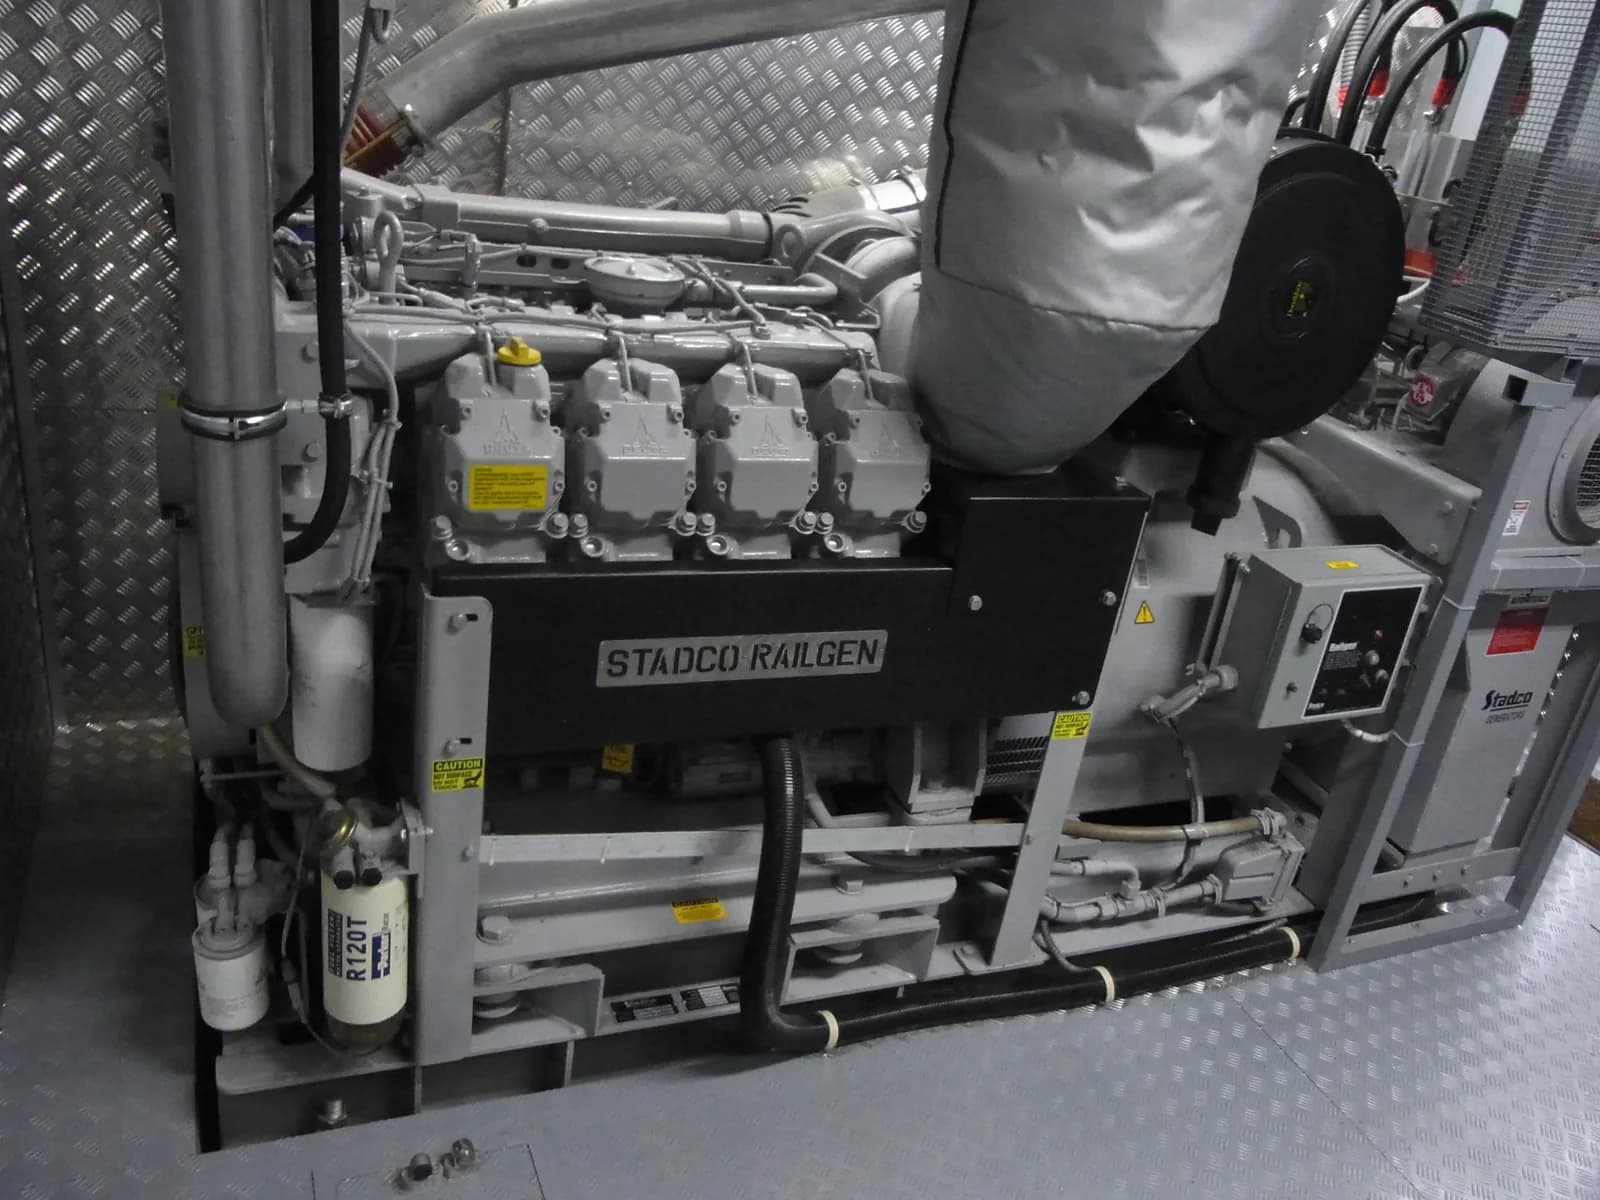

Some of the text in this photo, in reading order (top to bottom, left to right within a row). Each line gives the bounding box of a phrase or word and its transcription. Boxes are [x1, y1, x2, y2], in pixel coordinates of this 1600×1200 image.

[606, 639, 879, 677] STADCO RAILGEN
[1481, 690, 1533, 711] Stadco
[435, 760, 481, 771] CAUTION
[346, 915, 367, 981] R120T
